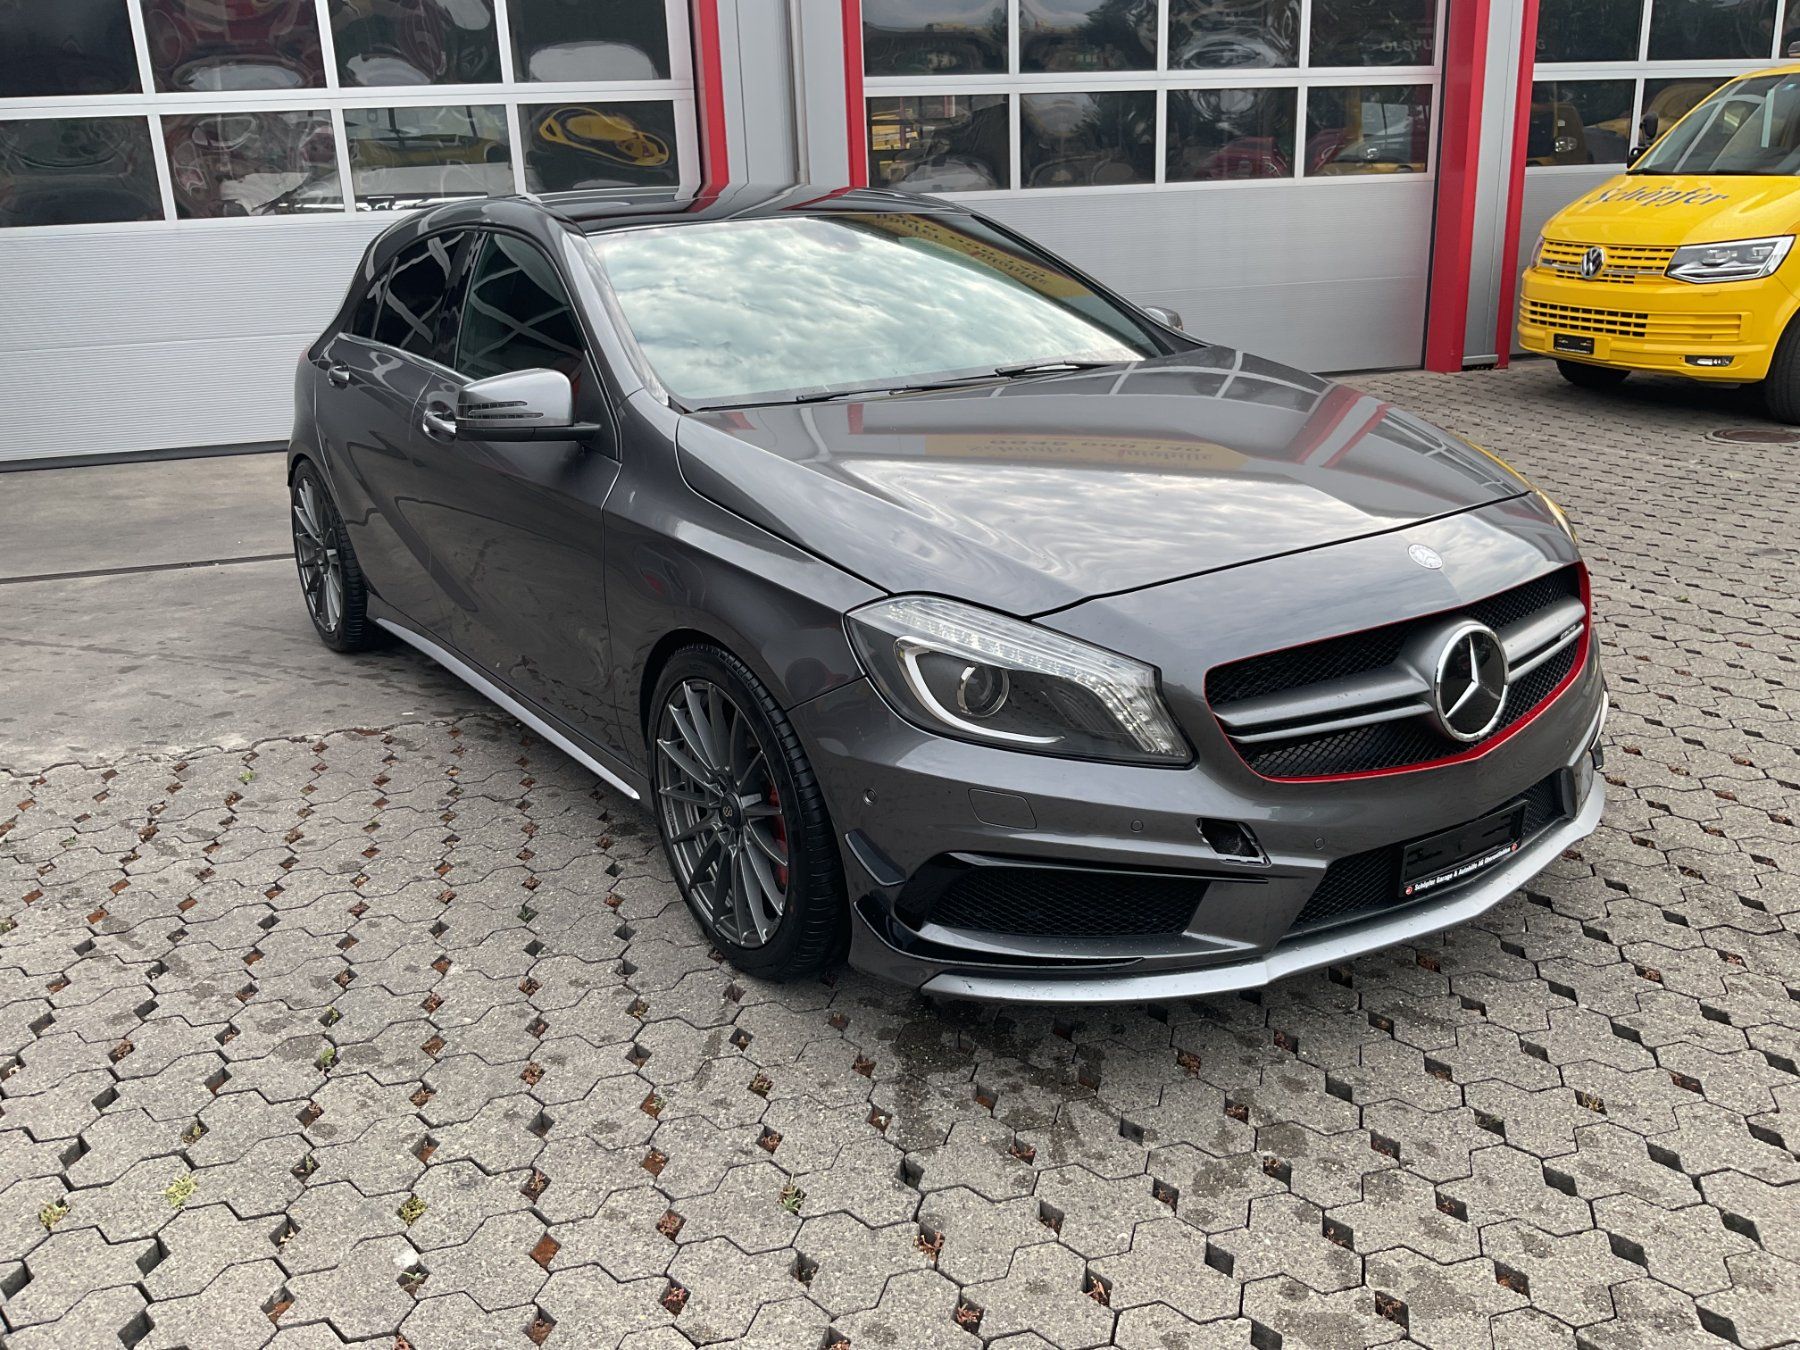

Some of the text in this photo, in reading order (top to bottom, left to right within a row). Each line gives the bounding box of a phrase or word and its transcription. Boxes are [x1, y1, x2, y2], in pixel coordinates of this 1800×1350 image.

[1585, 185, 1729, 207] Schöpfer
[1414, 879, 1436, 891] Schöpfer
[1436, 873, 1453, 884] Garage
